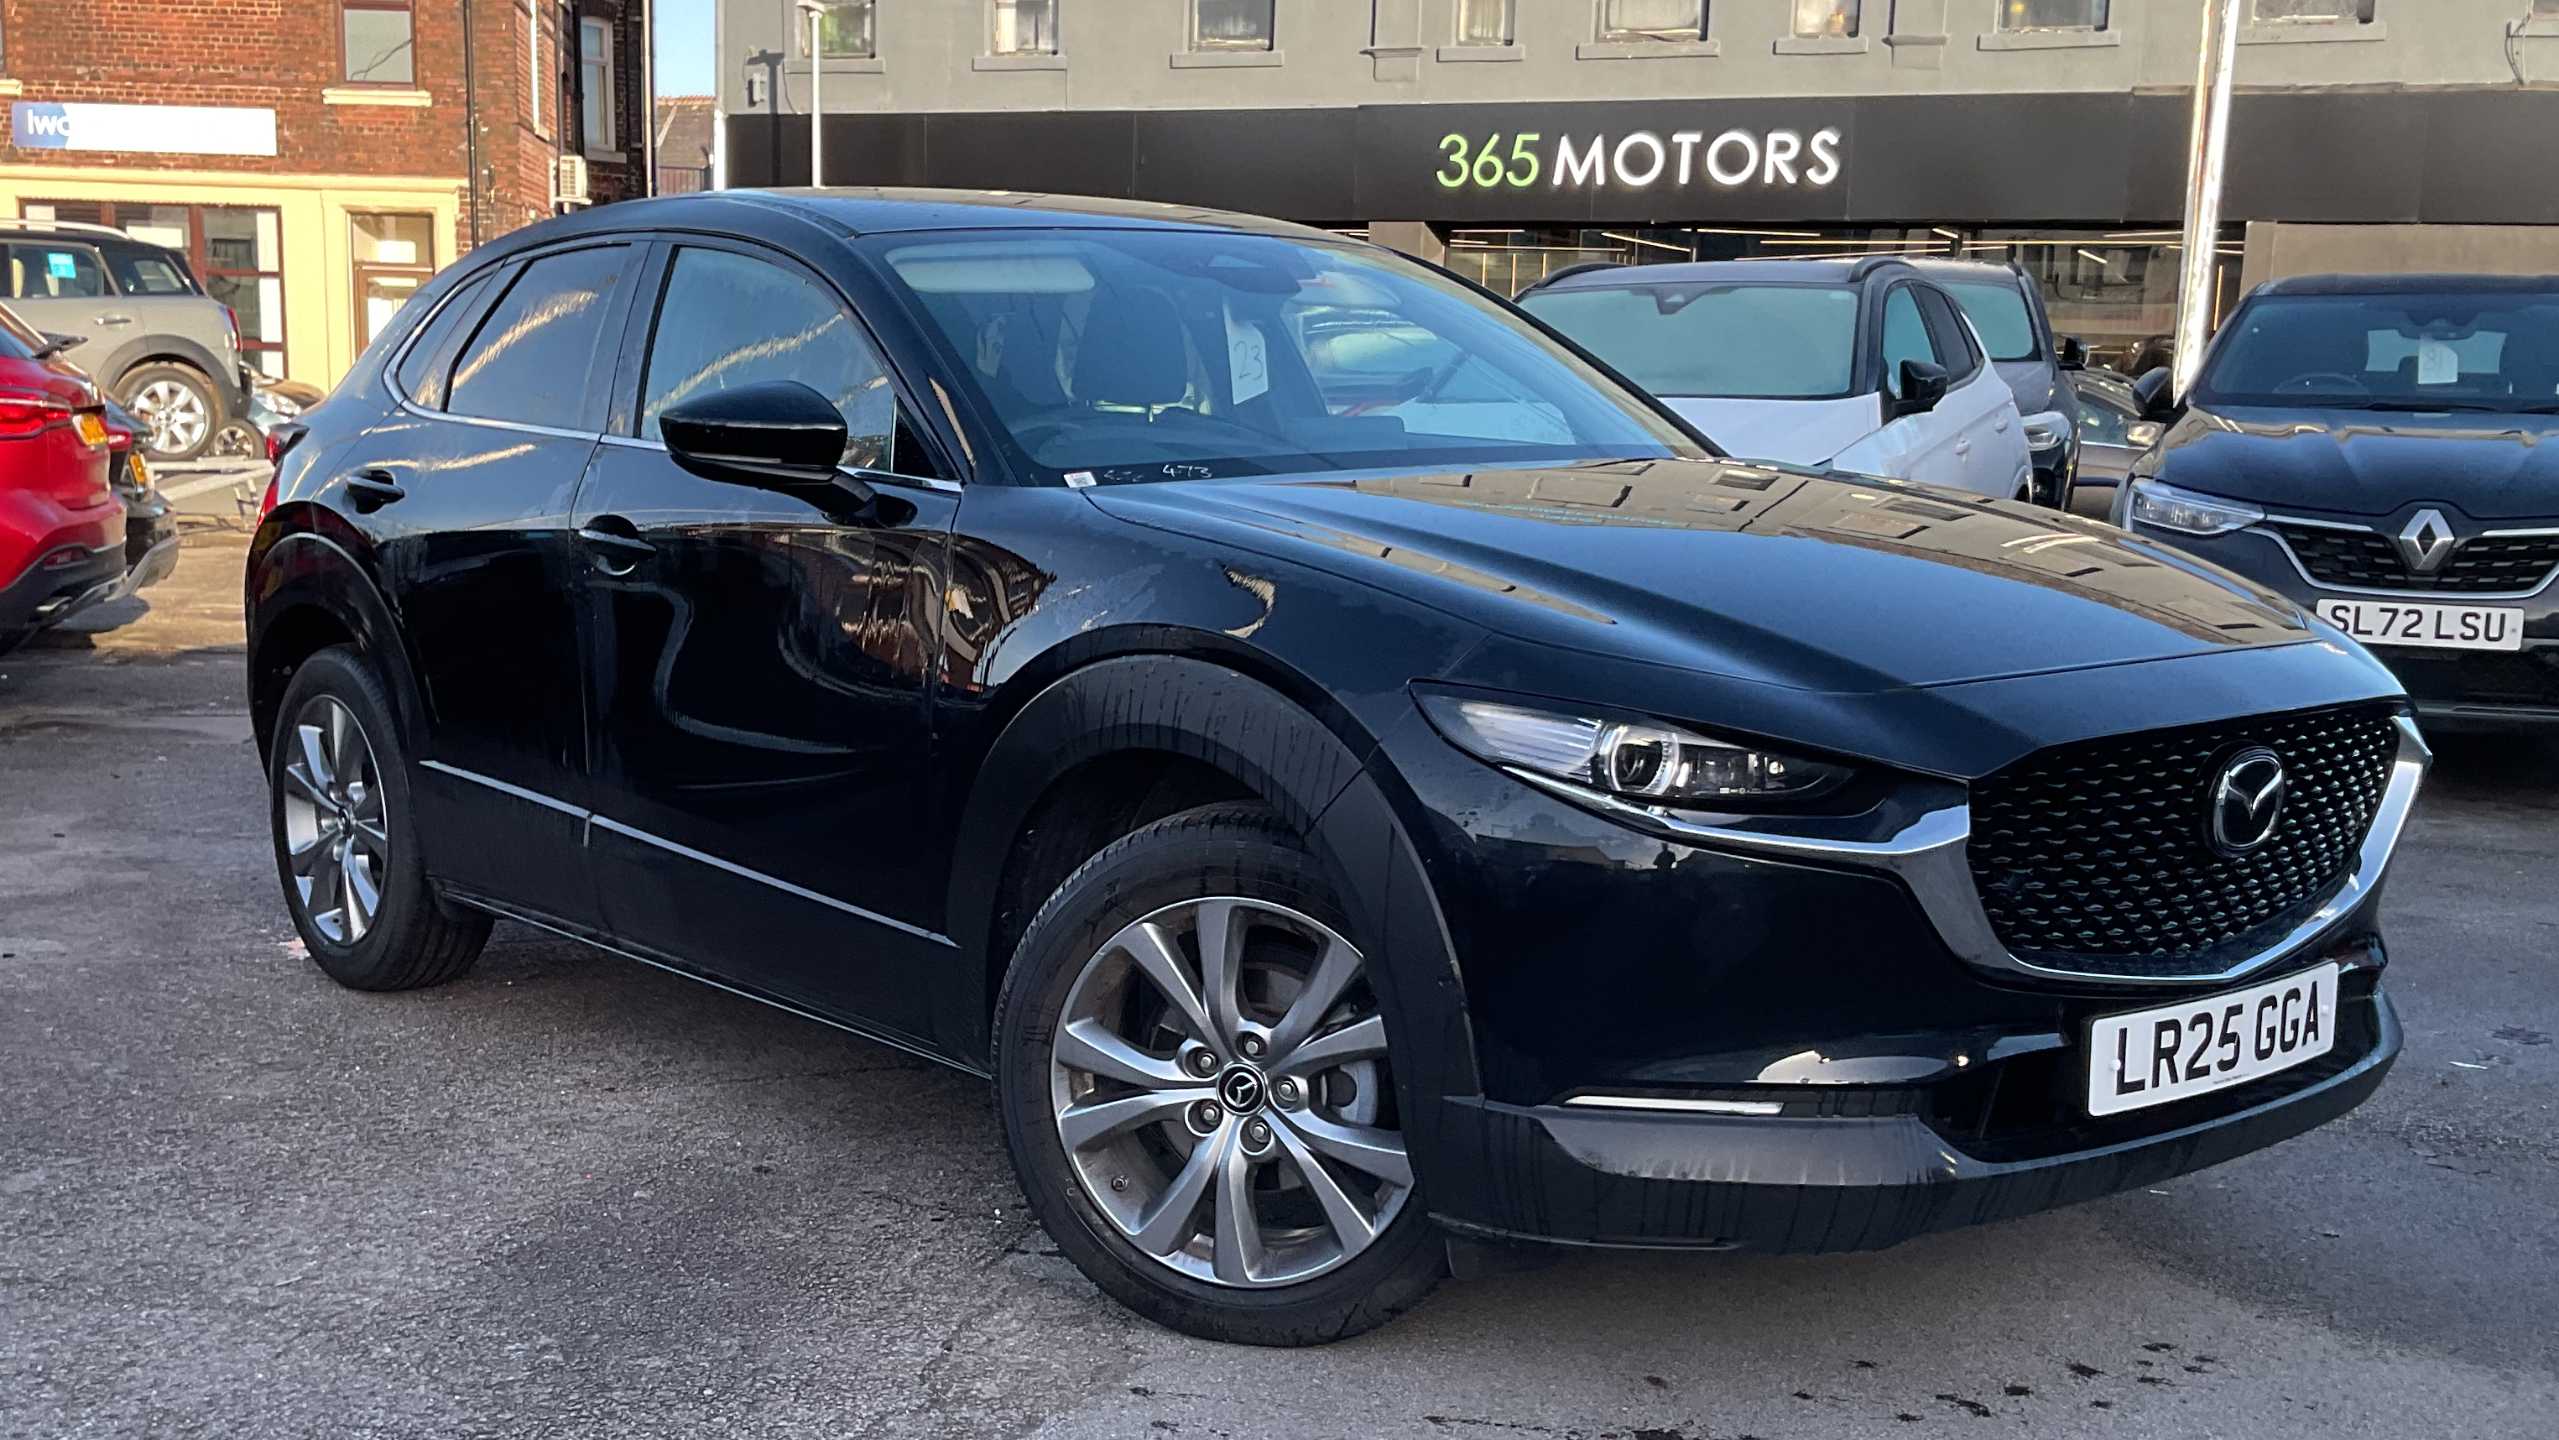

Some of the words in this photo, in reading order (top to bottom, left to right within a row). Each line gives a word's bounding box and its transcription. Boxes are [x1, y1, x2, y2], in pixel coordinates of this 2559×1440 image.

[1436, 133, 1541, 188] 365
[1552, 128, 1841, 187] MOTORS
[1233, 340, 1265, 381] 23
[2330, 604, 2424, 639] SL72
[2434, 610, 2507, 642] LSU
[2115, 1003, 2244, 1096] LR25
[2254, 981, 2320, 1062] GGA
